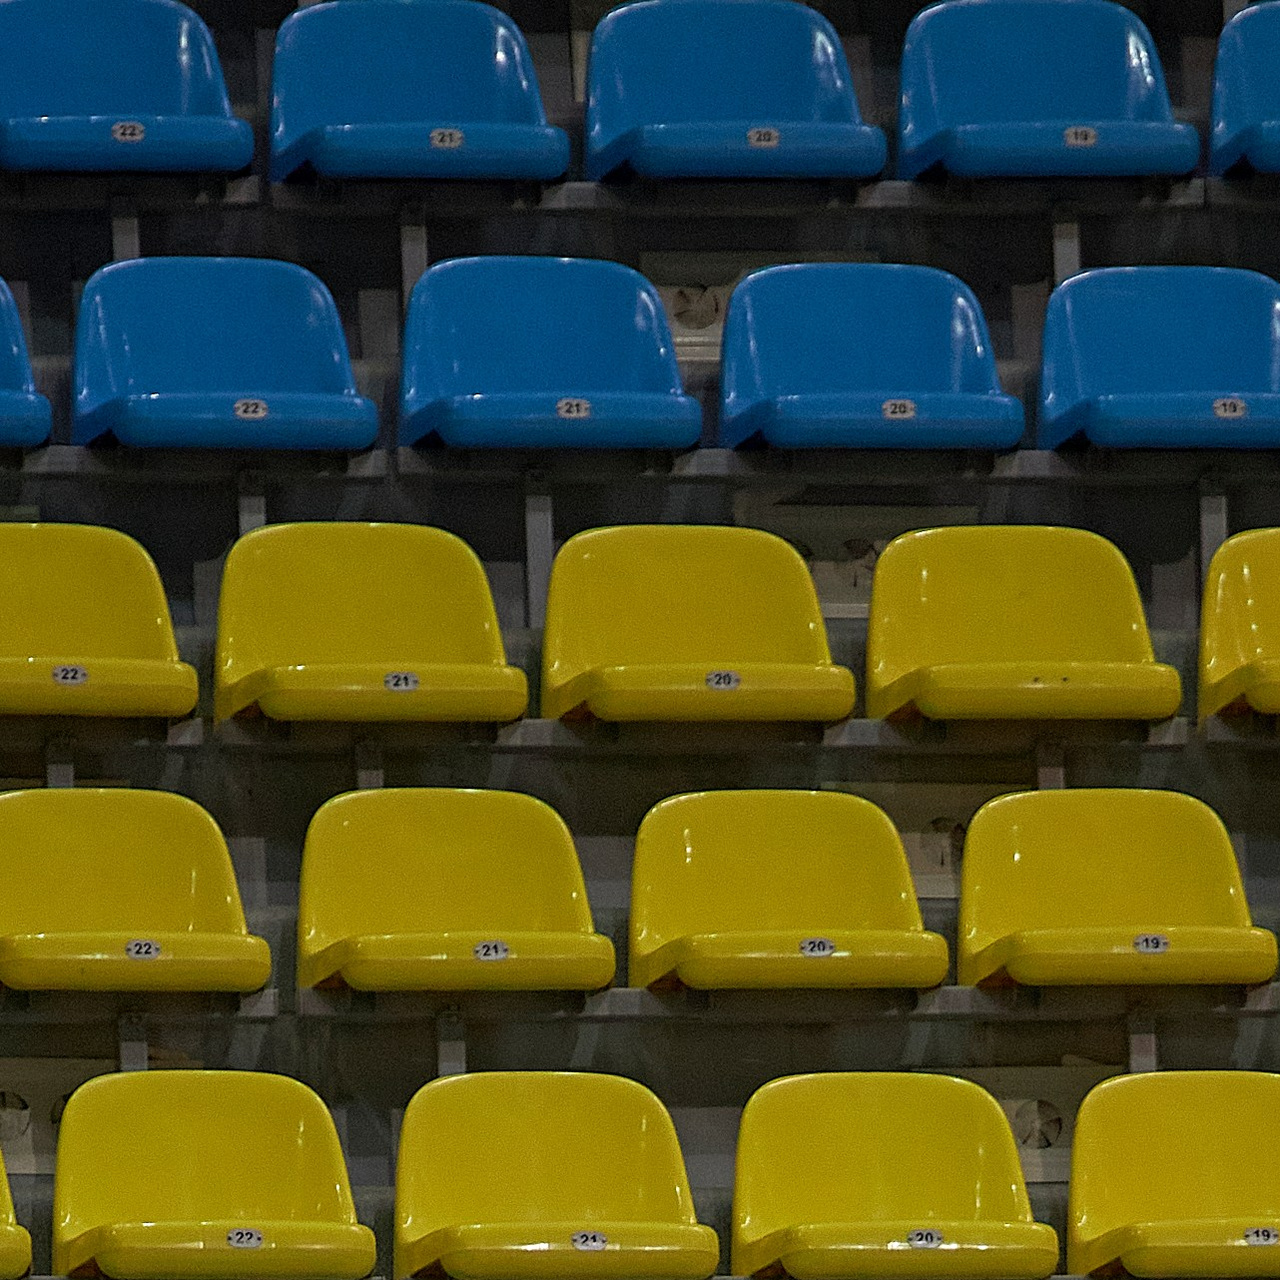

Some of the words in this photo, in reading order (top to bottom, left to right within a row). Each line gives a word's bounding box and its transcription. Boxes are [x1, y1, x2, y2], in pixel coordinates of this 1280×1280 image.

[120, 125, 136, 136] 22
[242, 403, 259, 413] 22
[565, 402, 580, 413] 21
[890, 403, 906, 413] 20
[61, 669, 78, 679] 22
[715, 674, 731, 685] 20
[393, 675, 409, 686] 21
[135, 943, 151, 954] 22
[808, 941, 825, 952] 20
[1143, 938, 1159, 948] 19
[483, 945, 498, 955] 21
[1254, 1230, 1270, 1241] 19
